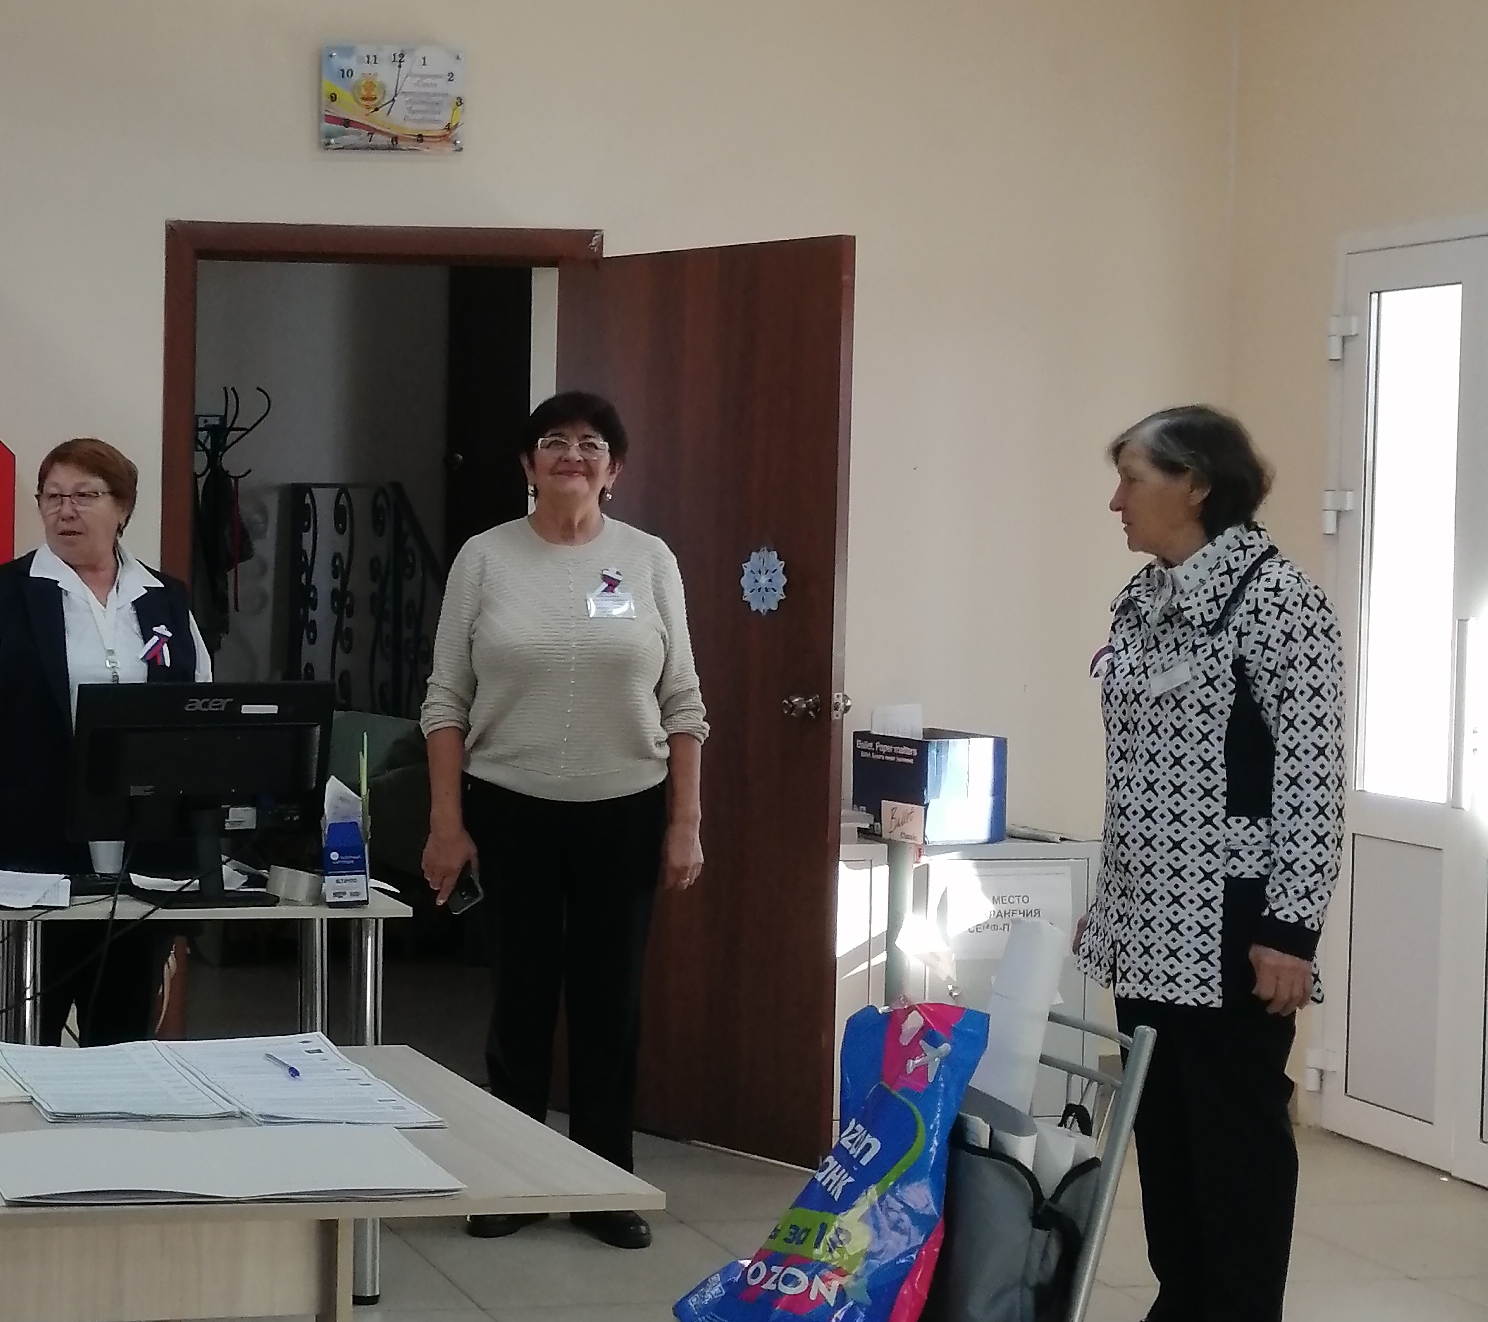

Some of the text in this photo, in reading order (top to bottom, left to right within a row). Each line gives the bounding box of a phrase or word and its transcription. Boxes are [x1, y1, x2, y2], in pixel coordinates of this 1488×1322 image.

[365, 54, 379, 65] 11
[391, 52, 405, 63] 12
[421, 56, 427, 66] 1
[340, 68, 354, 79] 10
[447, 72, 455, 82] 2
[329, 92, 338, 103] 9
[455, 96, 464, 107] 3
[367, 132, 375, 143] 7
[184, 698, 233, 711] acer
[992, 894, 1030, 905] МЕСТО
[987, 908, 1041, 919] РАНЕНИЯ
[747, 1260, 840, 1307] OZON
